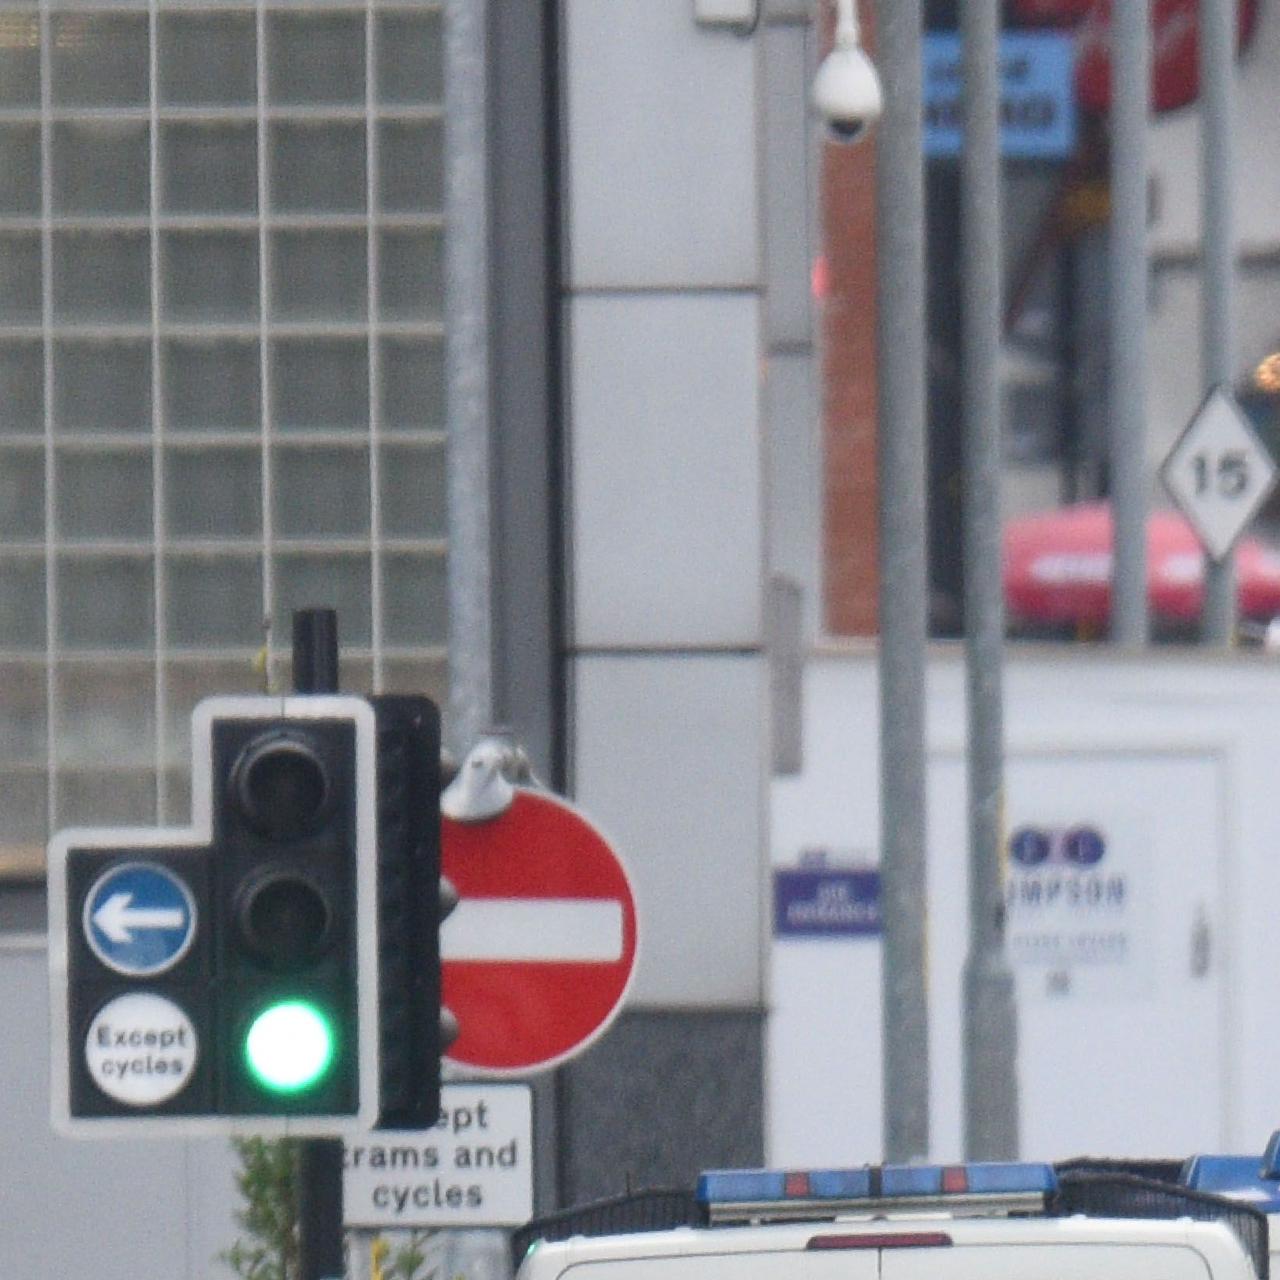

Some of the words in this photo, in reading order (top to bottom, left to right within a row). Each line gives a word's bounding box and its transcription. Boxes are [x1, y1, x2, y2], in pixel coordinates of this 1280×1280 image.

[1193, 451, 1248, 498] 15
[97, 1025, 186, 1050] Except
[102, 1054, 183, 1079] cycles
[438, 1102, 487, 1134] ept
[455, 1138, 517, 1168] and
[372, 1178, 483, 1214] cycles
